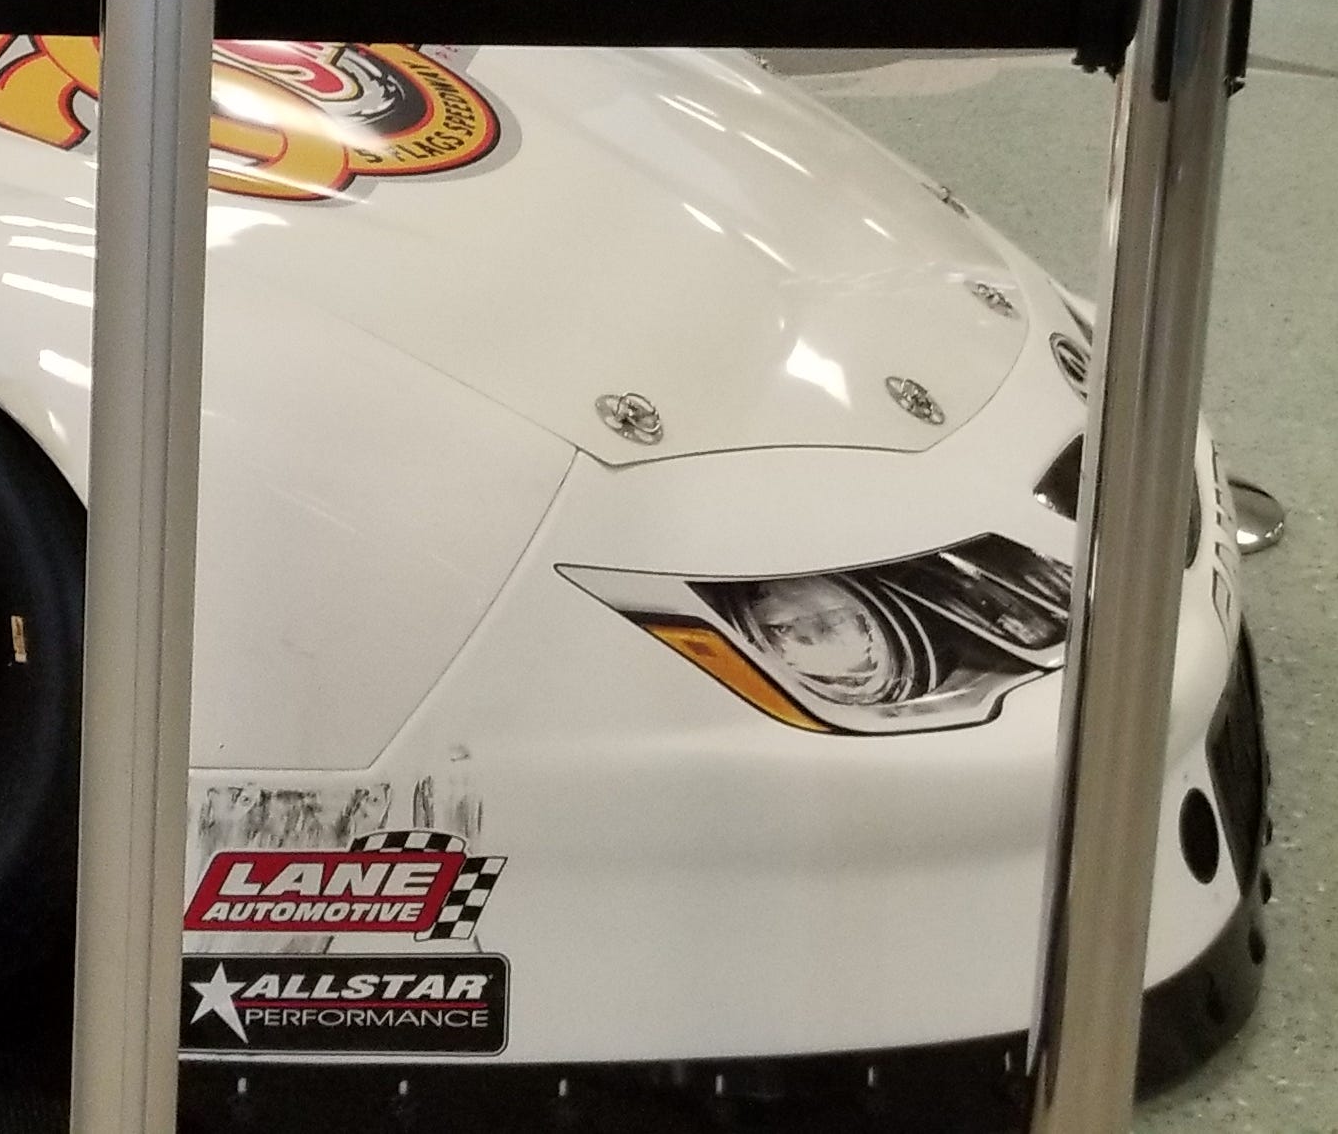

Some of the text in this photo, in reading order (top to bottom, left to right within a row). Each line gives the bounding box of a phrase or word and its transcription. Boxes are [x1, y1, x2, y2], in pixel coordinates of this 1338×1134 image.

[218, 862, 442, 897] LANE
[201, 901, 426, 923] AUTOMOTIVE
[239, 974, 489, 1000] ALLSTAR
[244, 1008, 489, 1028] PERFORMANCE
